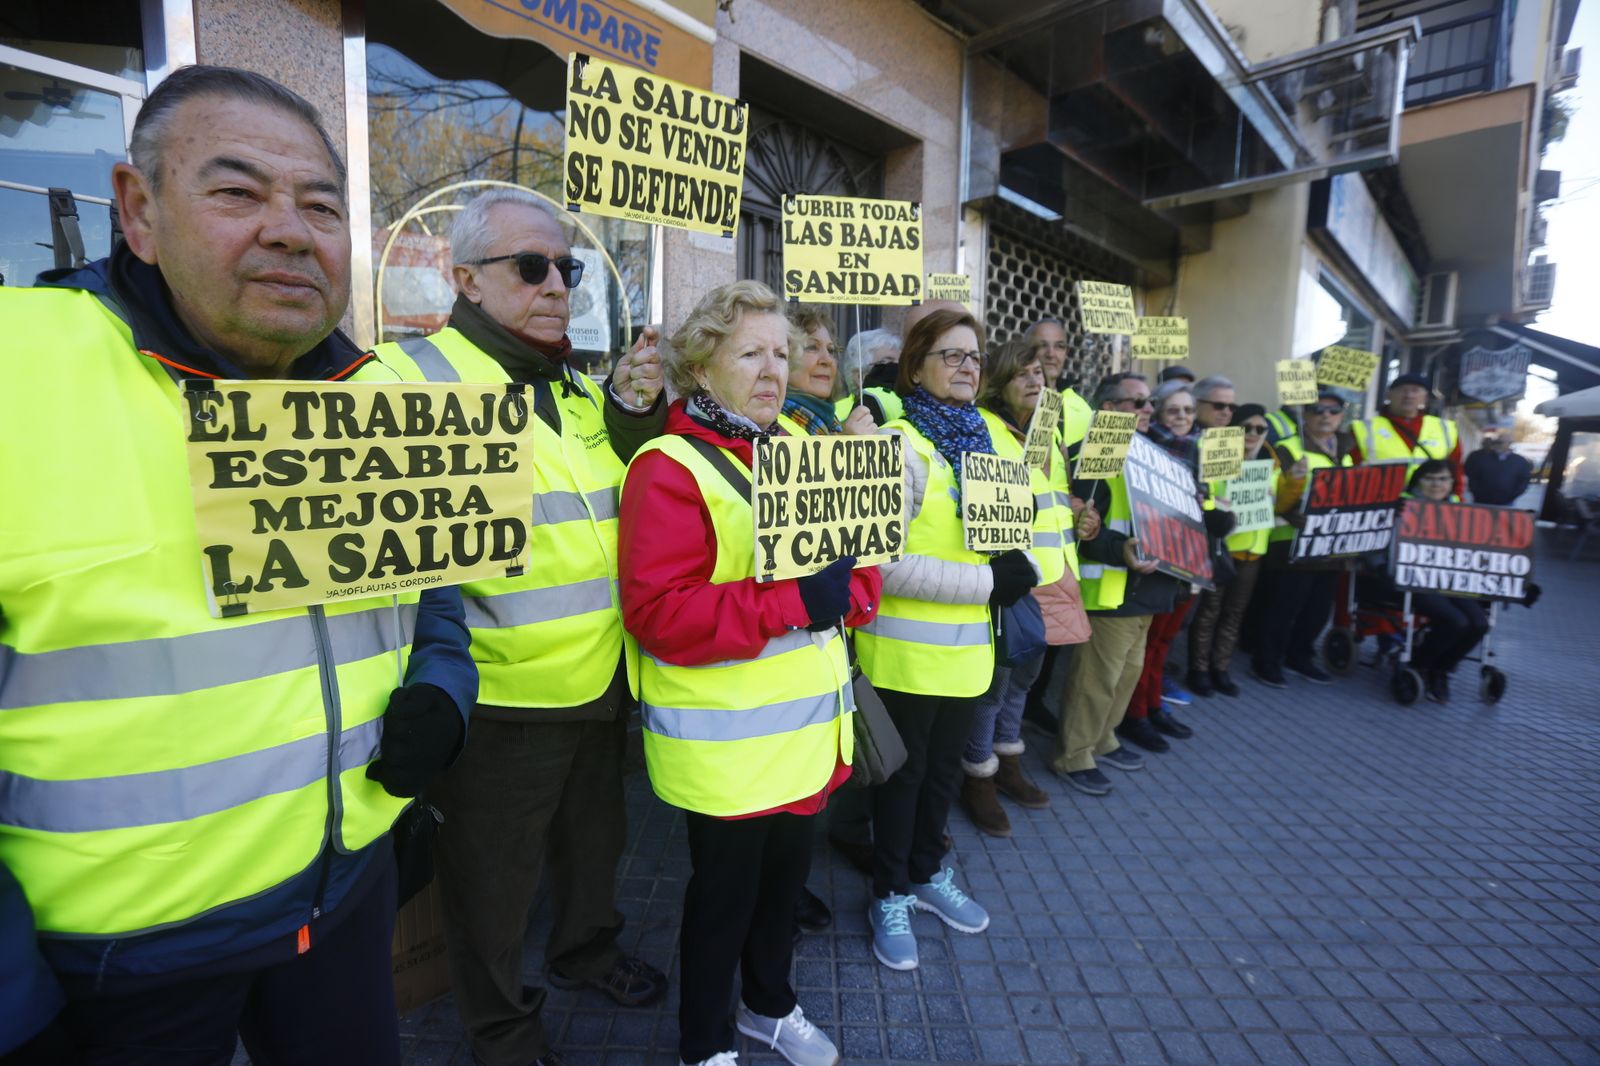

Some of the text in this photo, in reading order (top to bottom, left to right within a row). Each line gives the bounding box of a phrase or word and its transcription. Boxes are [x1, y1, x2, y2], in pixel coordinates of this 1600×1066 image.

[570, 62, 744, 135] LA SALUD
[569, 100, 742, 175] NO SE VENDE
[566, 151, 738, 228] SE DEFIENDE
[784, 199, 919, 222] CUBRIR TODAS
[784, 220, 920, 250] LAS BAJAS
[838, 252, 870, 269] EN
[785, 269, 920, 296] SANIDAD
[1080, 283, 1132, 297] SANIDAD
[1139, 318, 1178, 328] FUERA
[1132, 345, 1188, 355] SANIDAD
[1317, 369, 1367, 390] DIGNA
[187, 390, 528, 442] EL TRABAJO
[206, 442, 518, 488] ESTABLE
[757, 440, 902, 486] NO AL CIERRE
[965, 455, 1030, 486] RESCATEMOS
[1231, 466, 1268, 484] ANIDAD
[249, 485, 493, 534] MEJORA
[758, 483, 901, 529] DE SERVICIOS
[996, 487, 1010, 503] LA
[967, 503, 1032, 523] SANIDAD
[1399, 501, 1534, 549] SANIDAD
[758, 520, 901, 570] Y CAMAS
[967, 523, 1031, 544] PÚBLICA
[204, 517, 527, 597] LA SALUD
[1398, 542, 1531, 576] DERECHO
[326, 575, 443, 598] YAYOFLAUTAS CORDOBA
[1395, 564, 1527, 598] UNIVERSAL
